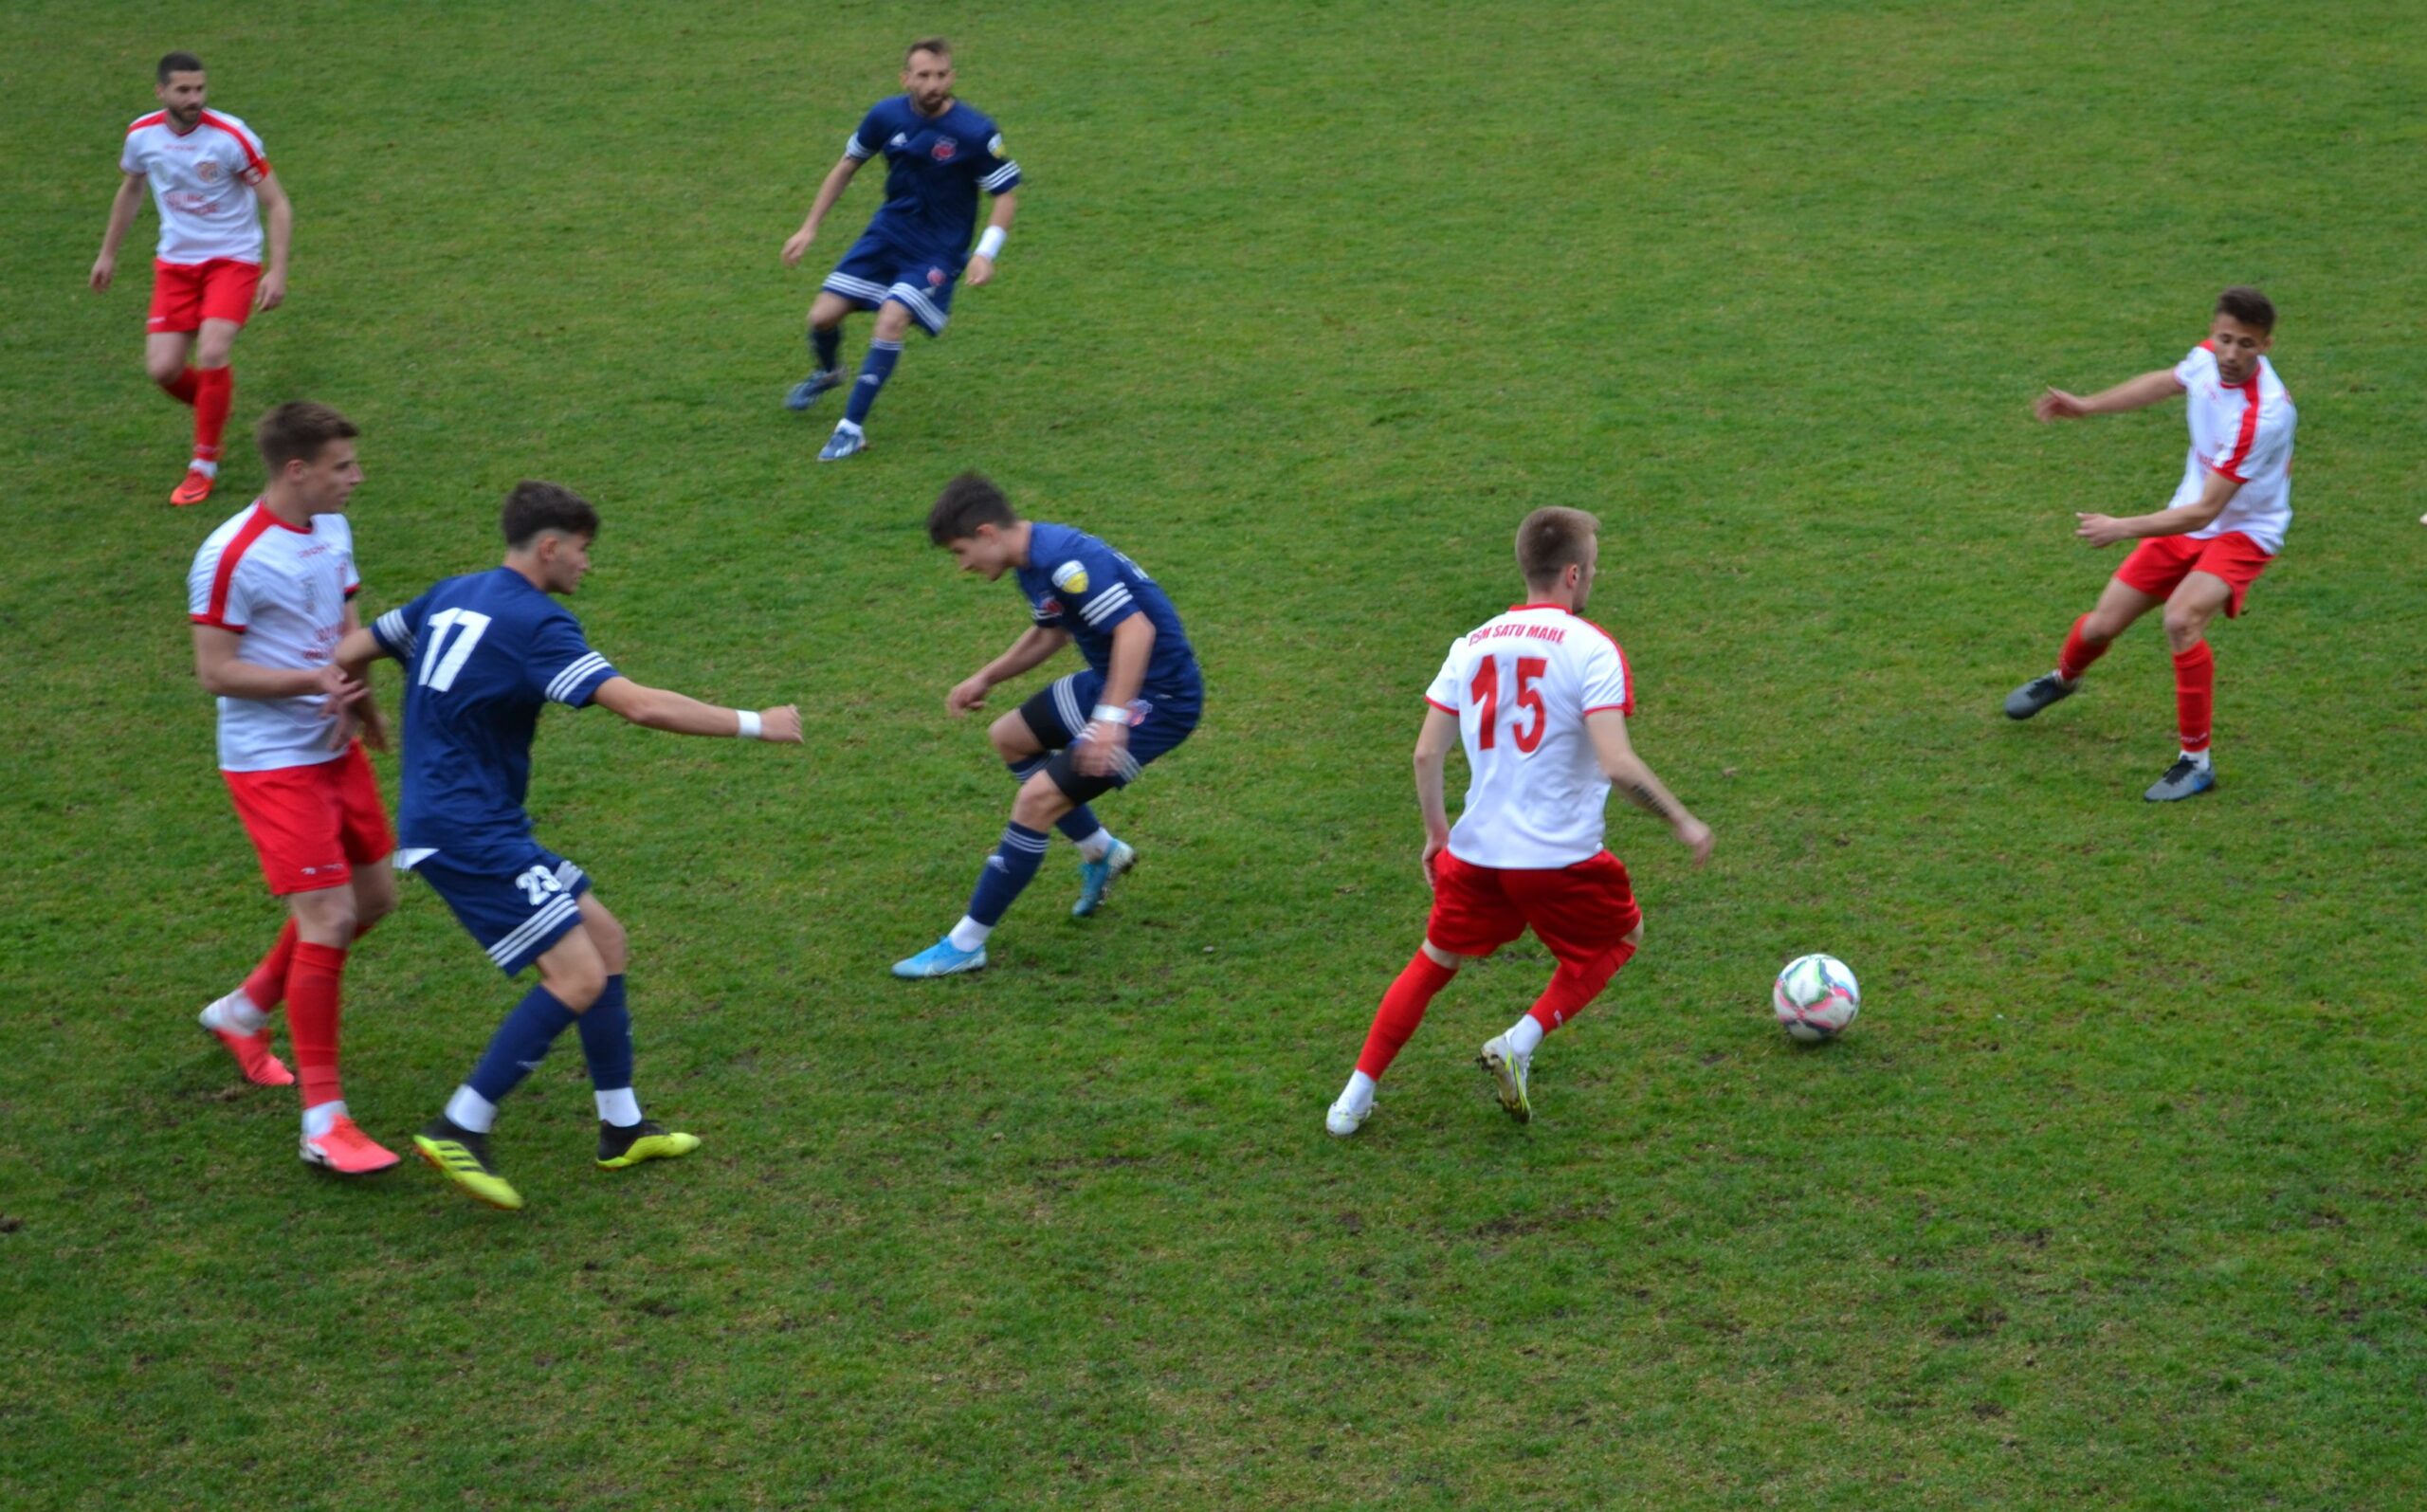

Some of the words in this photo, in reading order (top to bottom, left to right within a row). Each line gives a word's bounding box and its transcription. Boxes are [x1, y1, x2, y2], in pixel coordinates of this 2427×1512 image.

[417, 607, 492, 693] 17
[1492, 624, 1525, 638] SATU
[1525, 624, 1567, 646] MARE
[1471, 654, 1547, 753] 15
